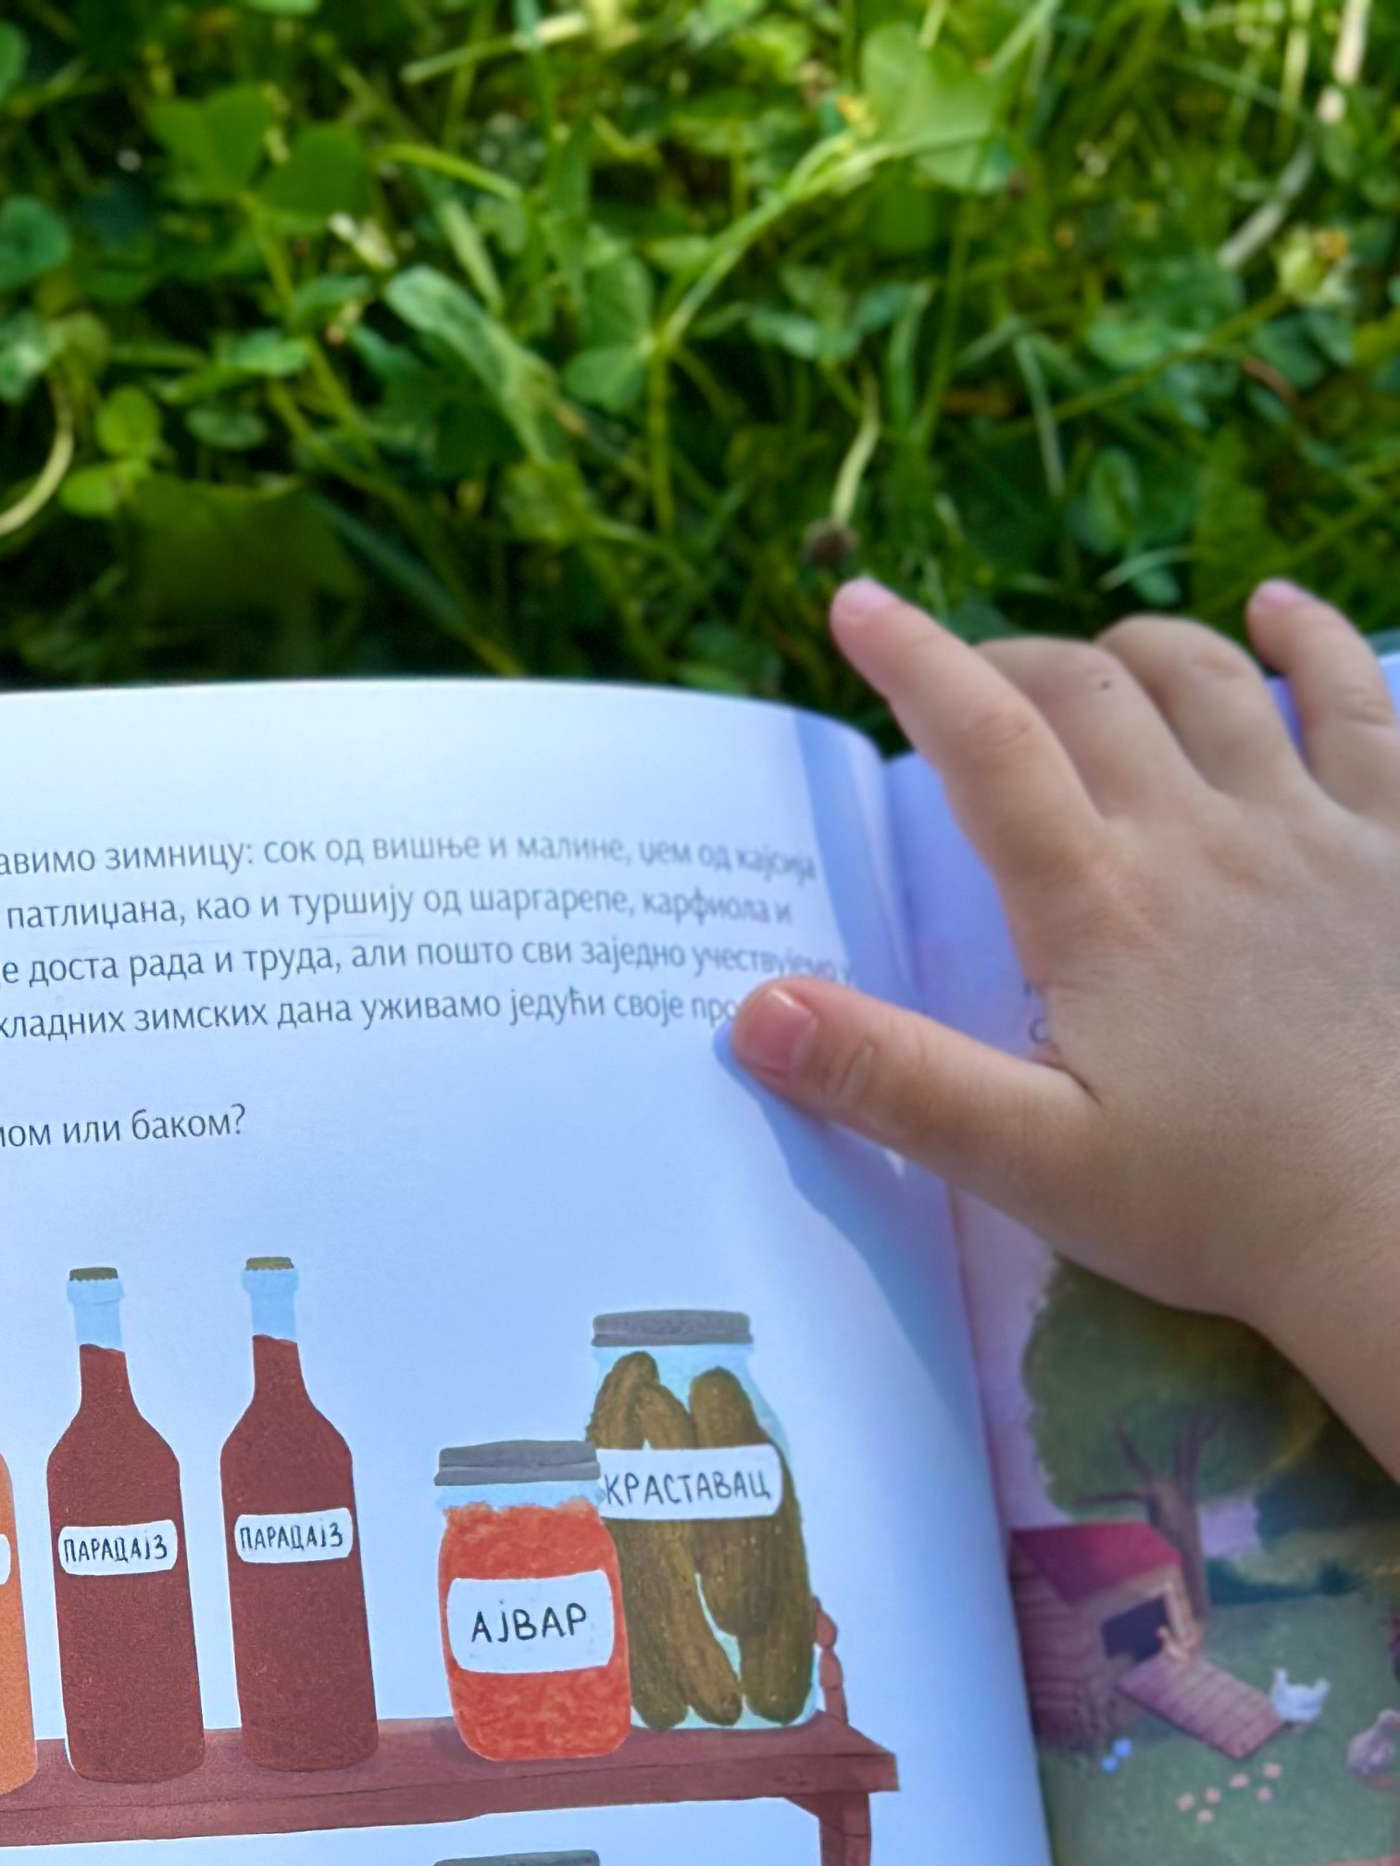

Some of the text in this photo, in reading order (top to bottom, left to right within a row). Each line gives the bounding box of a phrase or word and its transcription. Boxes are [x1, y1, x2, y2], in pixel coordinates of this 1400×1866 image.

[106, 843, 252, 874] зимницу:
[264, 841, 316, 863] сок
[326, 839, 364, 865] од
[373, 836, 480, 859] вишње
[489, 838, 507, 857] и
[517, 836, 631, 864] малине,
[638, 840, 691, 866] џем
[698, 844, 732, 872] од
[8, 900, 185, 929] патлиџана,
[197, 897, 249, 919] као
[261, 896, 278, 917] и
[289, 892, 413, 925] туршију
[424, 889, 462, 916] од
[470, 889, 634, 920] шаргарепе,
[642, 888, 770, 925] карфиола
[776, 904, 791, 923] и
[29, 957, 119, 988] доста
[130, 953, 204, 983] рада
[215, 952, 232, 973] и
[242, 948, 341, 976] труда,
[352, 945, 406, 967] али
[418, 942, 513, 965] пошто
[522, 942, 572, 963] сви
[581, 936, 686, 974] заједно
[135, 1004, 268, 1031] зимских
[277, 1000, 352, 1029] дана
[361, 996, 500, 1030] уживамо
[510, 986, 604, 1026] једући
[614, 990, 683, 1027] своје
[691, 997, 735, 1027] про
[64, 1120, 120, 1143] или
[132, 1103, 245, 1140] баком?
[605, 1471, 771, 1506] КРАСТАВАЦ
[64, 1535, 167, 1563] ПАРАДАЈЗ
[240, 1523, 343, 1550] ПАРАДАЈЗ
[472, 1603, 586, 1642] АЈВАР
